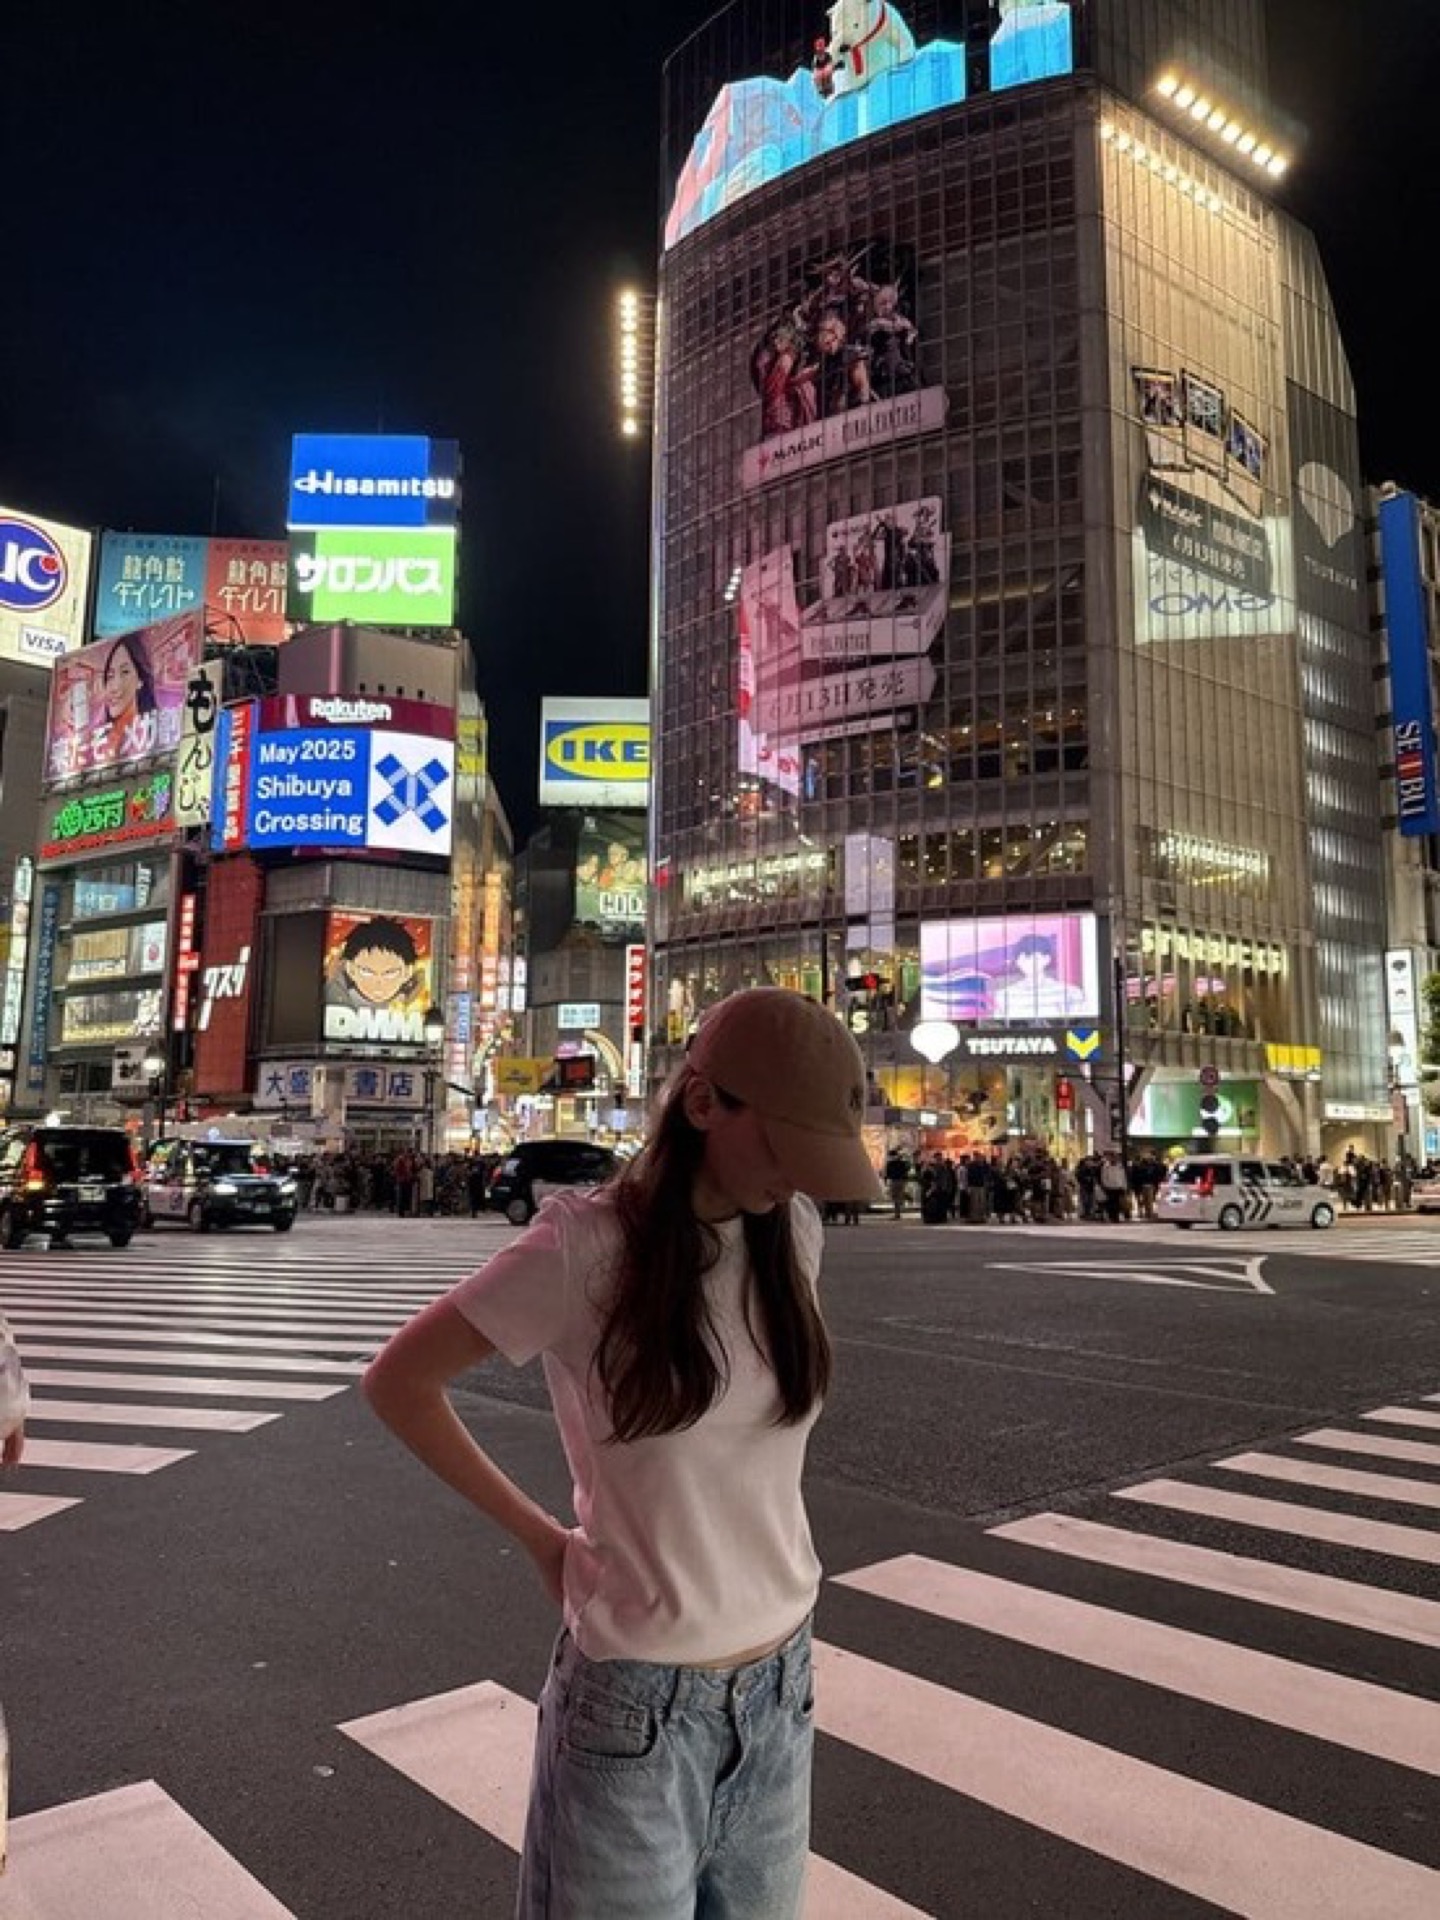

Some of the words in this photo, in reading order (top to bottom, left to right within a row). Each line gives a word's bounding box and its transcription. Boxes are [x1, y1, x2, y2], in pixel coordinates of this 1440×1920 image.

[294, 469, 455, 498] Hisamitsu
[294, 553, 442, 596] サロンパス
[26, 632, 66, 653] VISA
[310, 698, 392, 720] Rakuten
[260, 743, 298, 764] May
[301, 740, 355, 760] 2025
[562, 740, 648, 762] IKE
[1395, 720, 1426, 815] SEIBU
[258, 774, 353, 799] Shibuya
[255, 808, 365, 836] Crossing
[1141, 928, 1288, 973] STARBUCKS
[325, 1004, 424, 1041] DMM
[966, 1038, 1058, 1055] TSUTAYA
